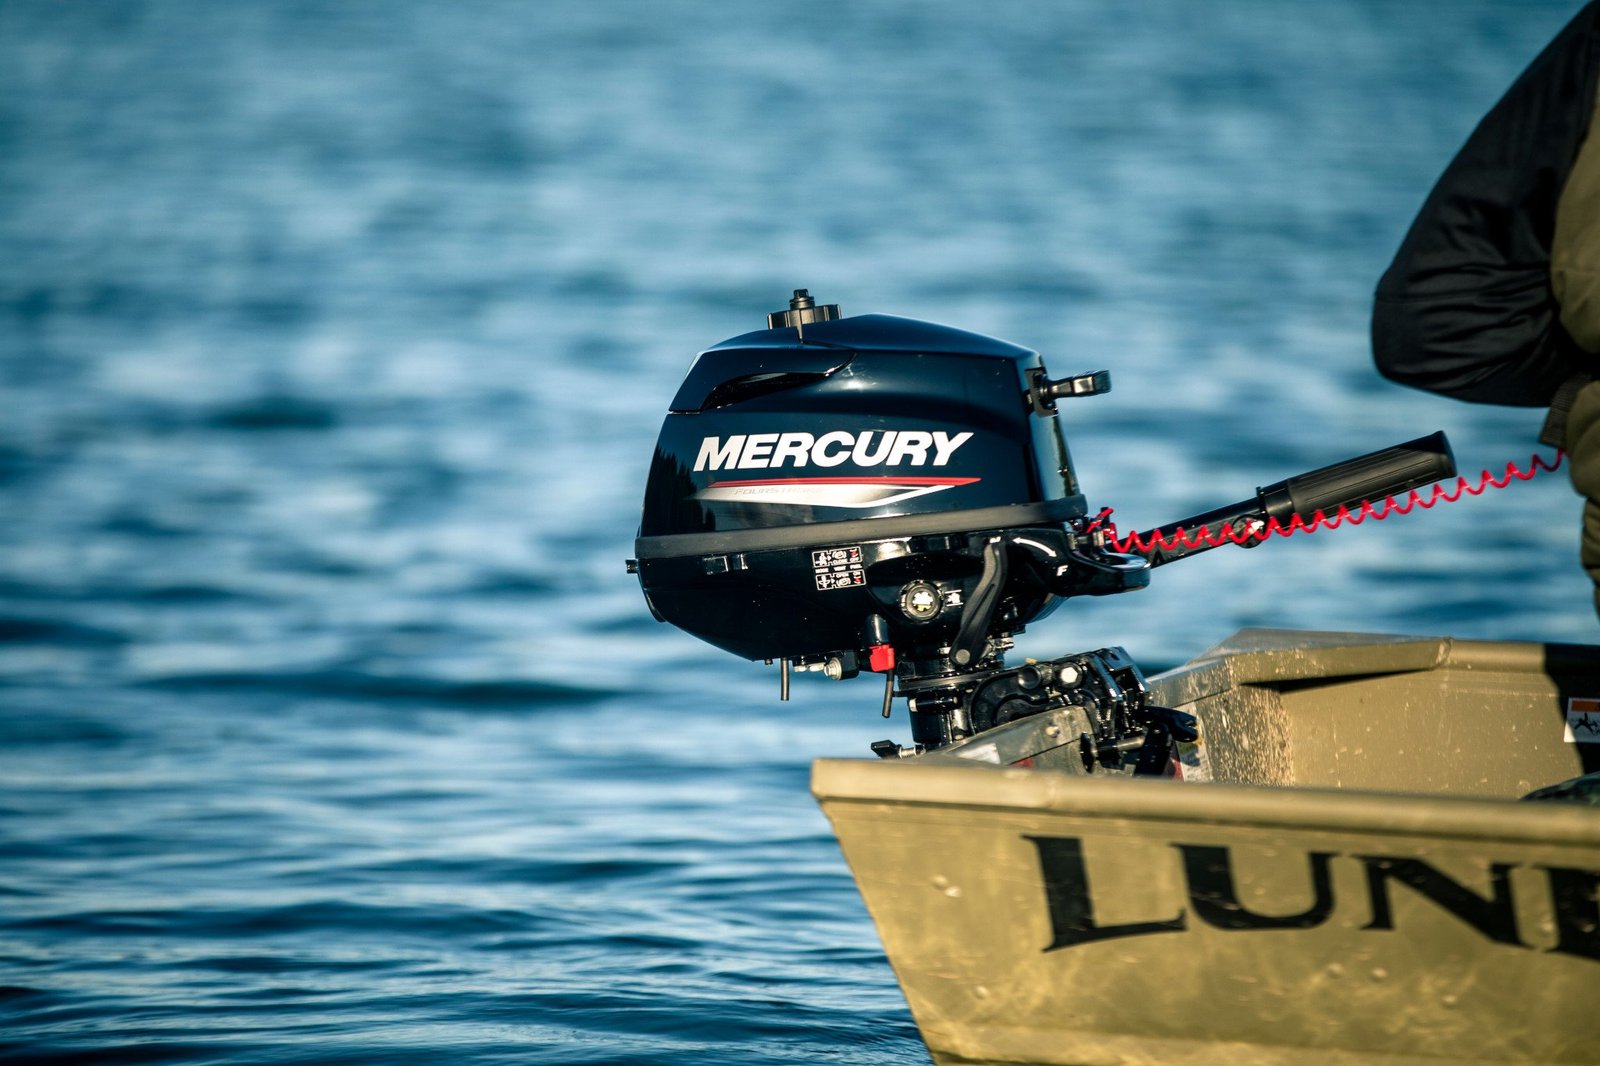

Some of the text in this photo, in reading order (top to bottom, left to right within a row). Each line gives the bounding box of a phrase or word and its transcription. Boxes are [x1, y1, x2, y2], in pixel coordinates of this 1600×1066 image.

[693, 430, 974, 471] MERCURY
[734, 486, 824, 496] FOURST
[1057, 565, 1068, 576] F
